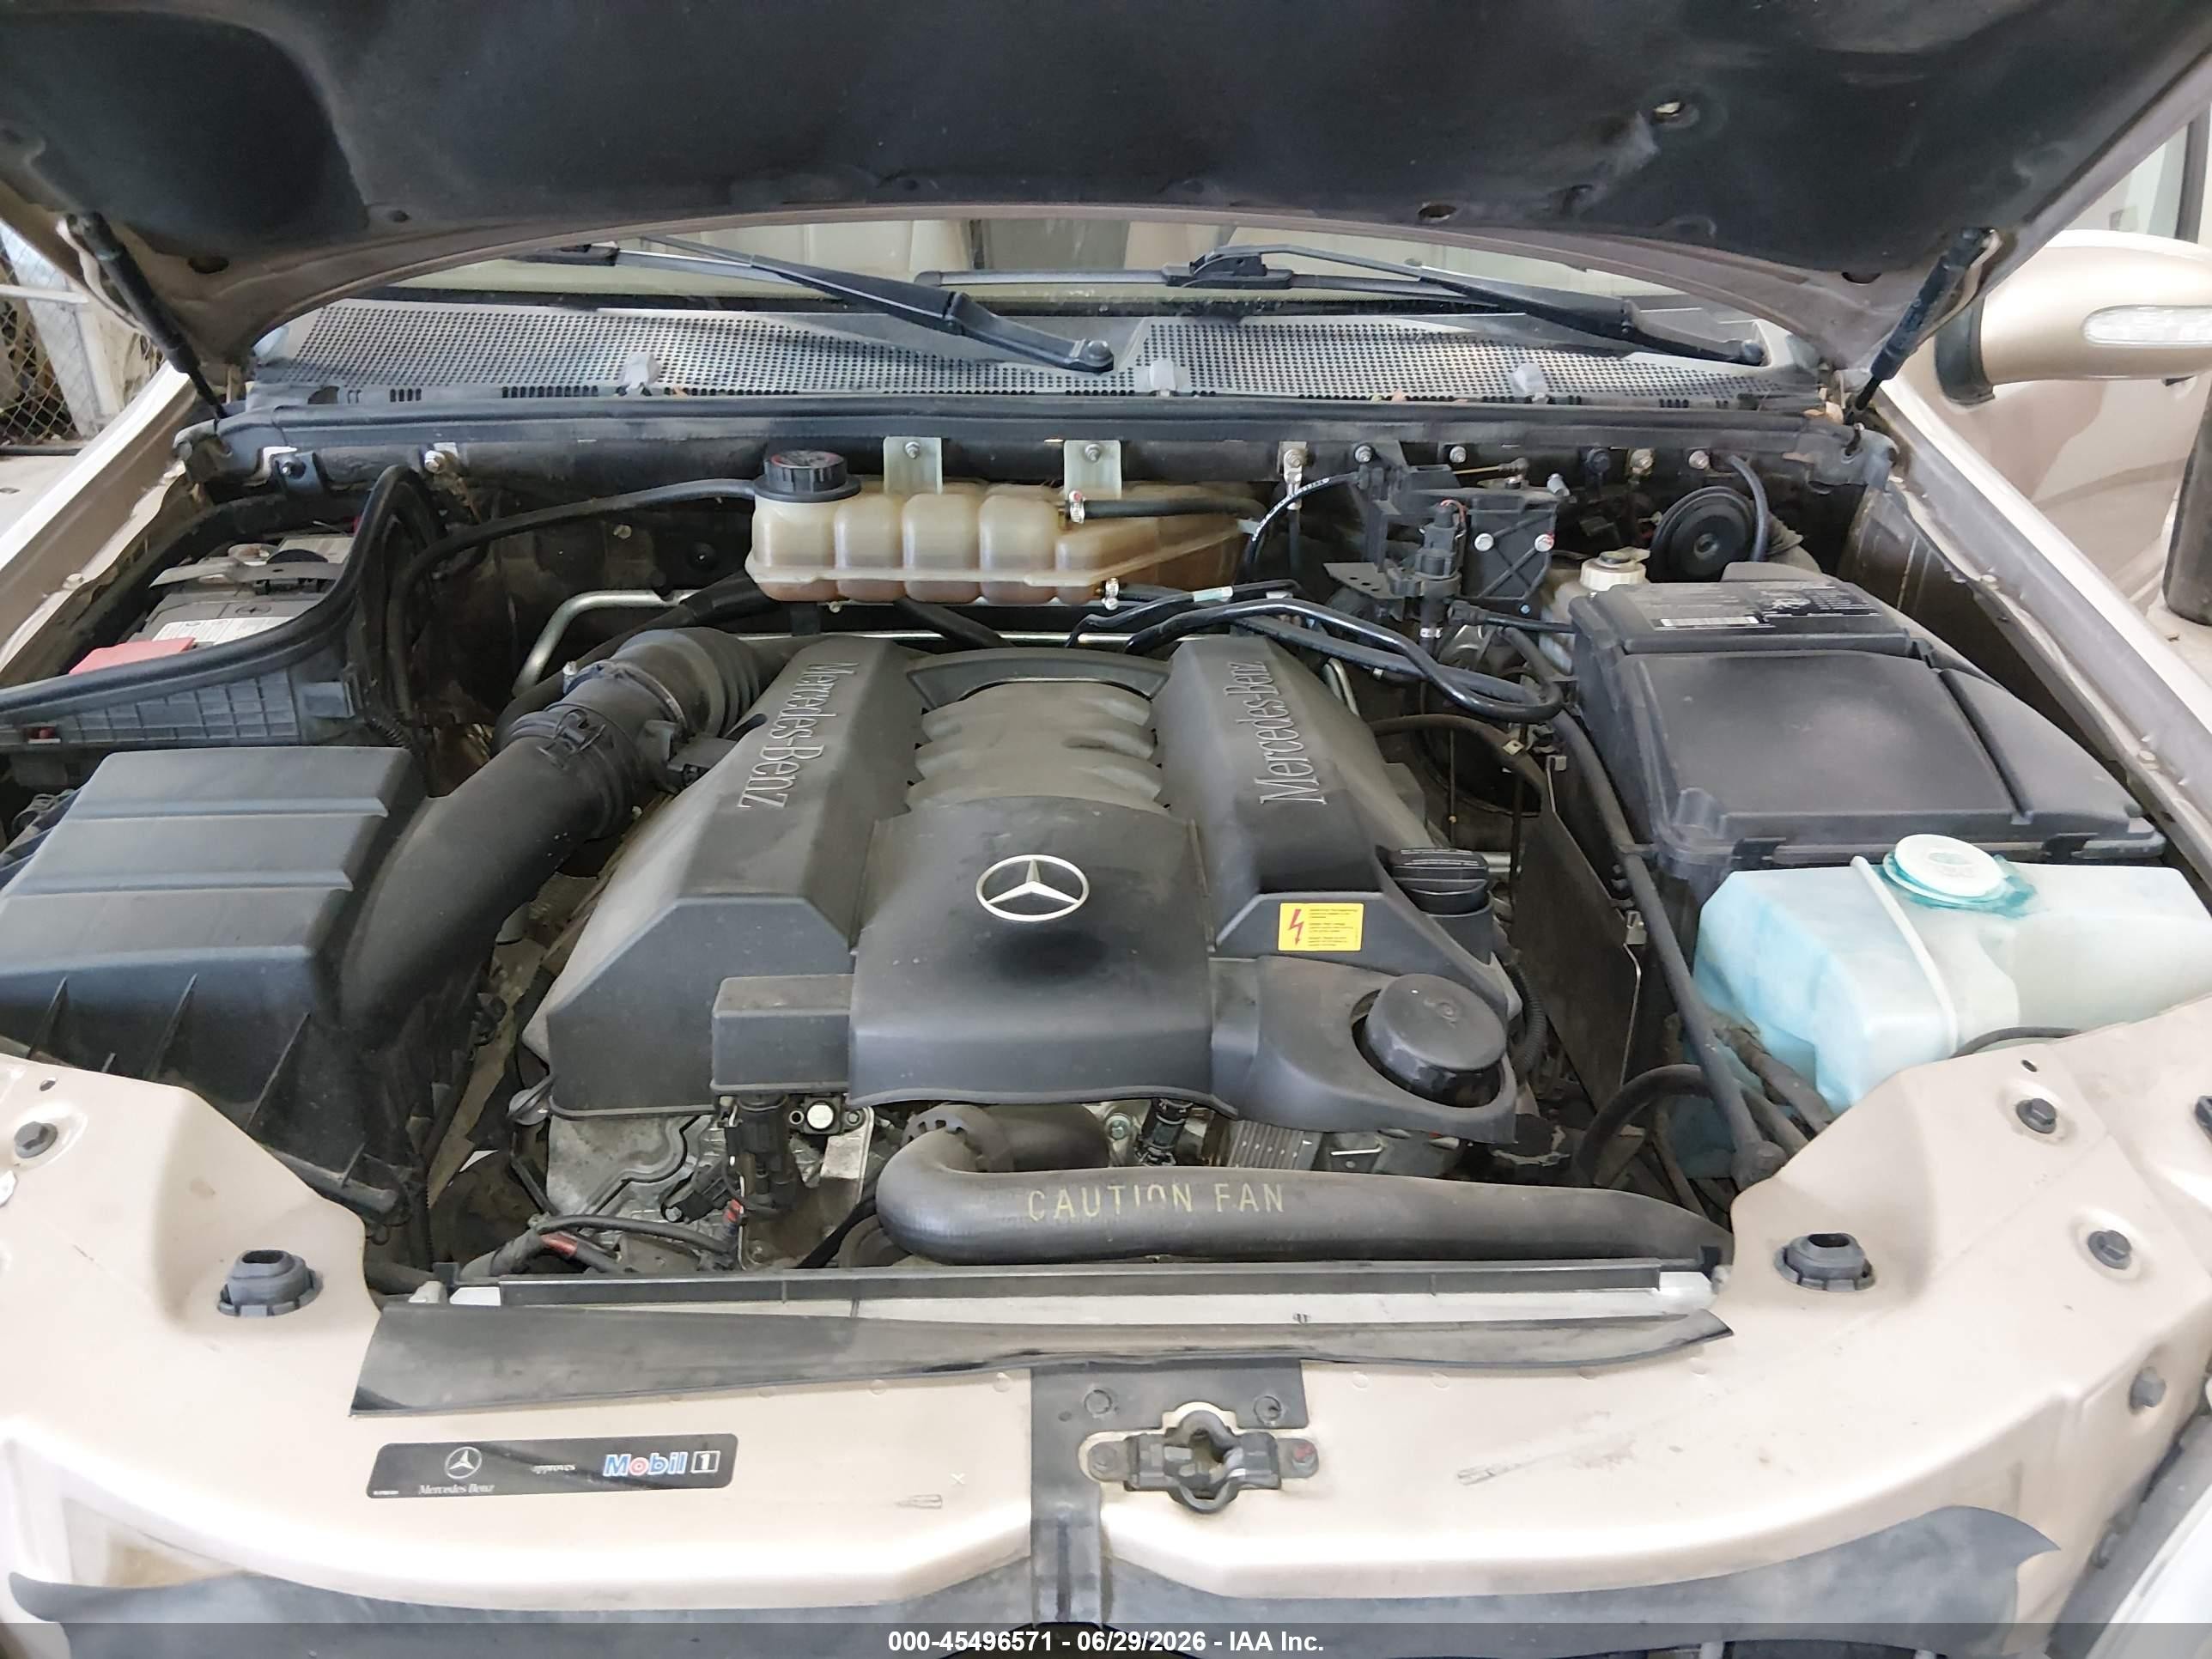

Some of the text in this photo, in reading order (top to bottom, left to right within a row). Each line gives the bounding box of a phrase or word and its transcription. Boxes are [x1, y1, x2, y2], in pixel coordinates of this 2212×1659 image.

[737, 662, 859, 808] Mercedes-Benz
[1223, 660, 1328, 805] Mercedes-Benz
[1028, 1182, 1284, 1221] CAUTION FAN
[603, 1451, 688, 1477] Mobil
